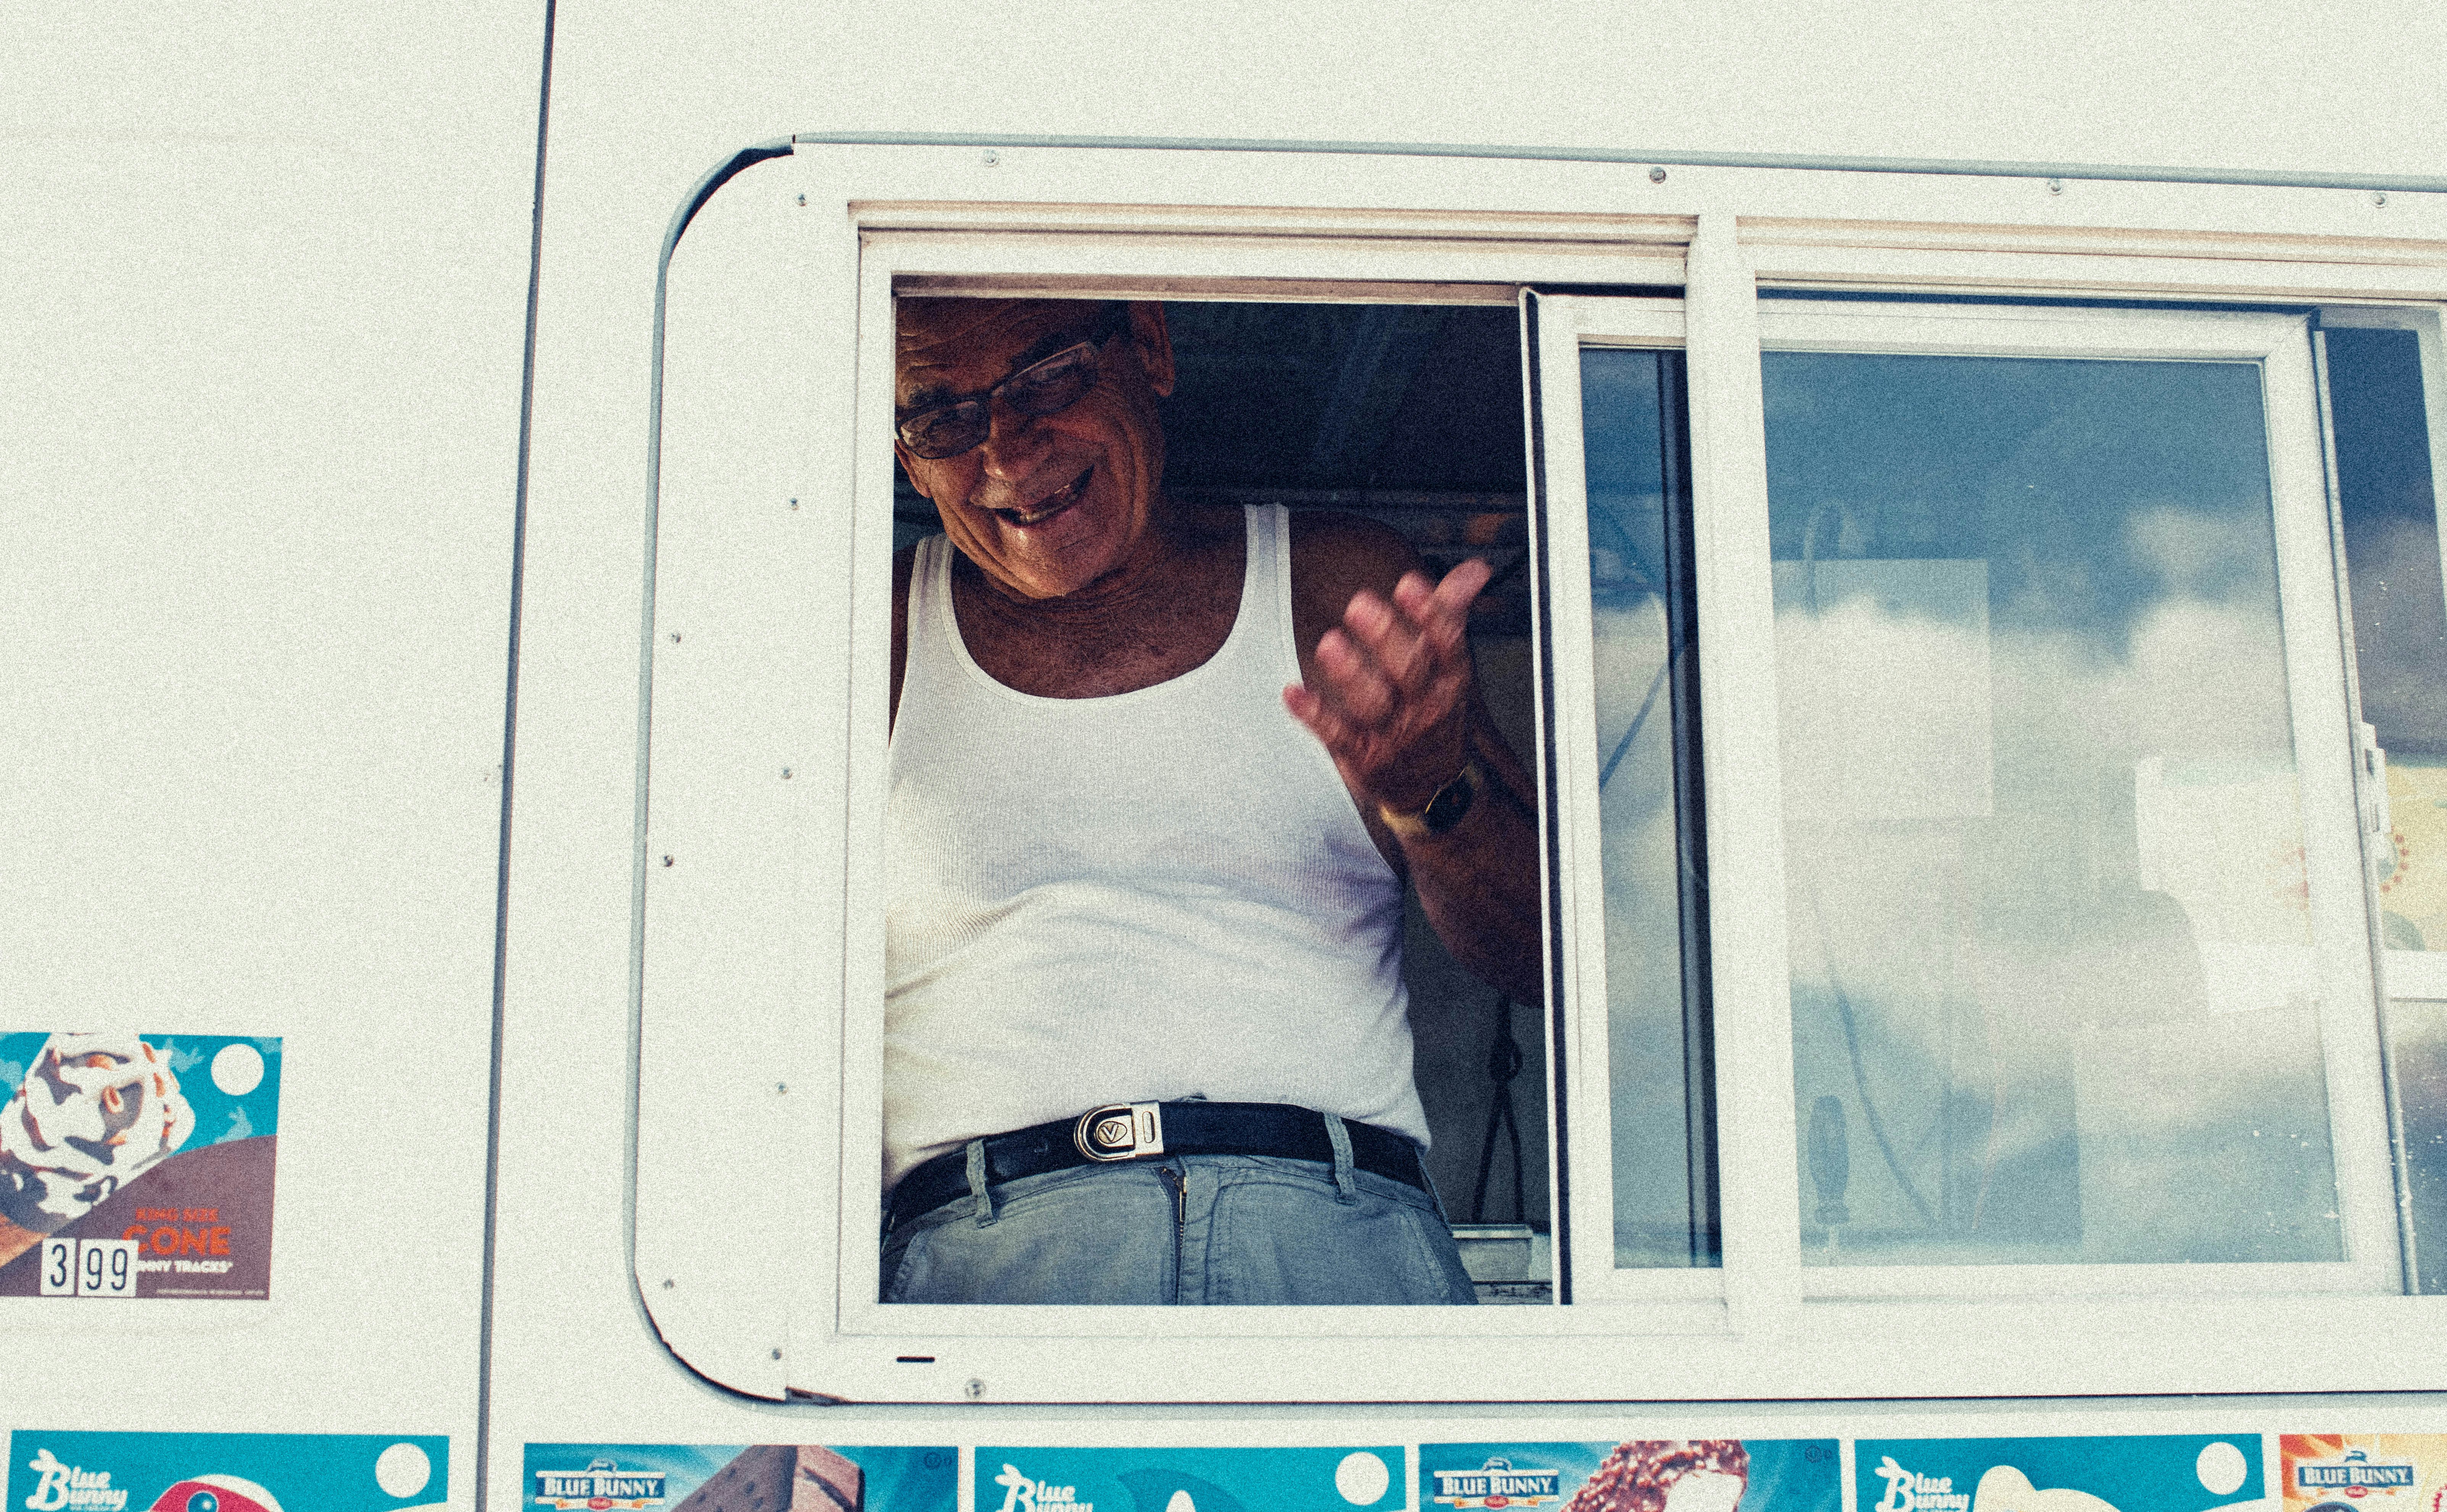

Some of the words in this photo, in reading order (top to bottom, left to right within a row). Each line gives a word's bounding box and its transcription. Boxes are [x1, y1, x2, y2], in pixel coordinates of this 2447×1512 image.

[136, 1207, 178, 1221] KING
[183, 1208, 219, 1222] SIZE
[122, 1225, 231, 1256] CONE
[1442, 1476, 1487, 1495] BLUE
[1490, 1475, 1552, 1494] BUNNY
[2304, 1467, 2347, 1484] BLUE
[2349, 1467, 2408, 1484] BUNNY
[544, 1477, 590, 1495] BLUE
[593, 1477, 658, 1496] BUNNY
